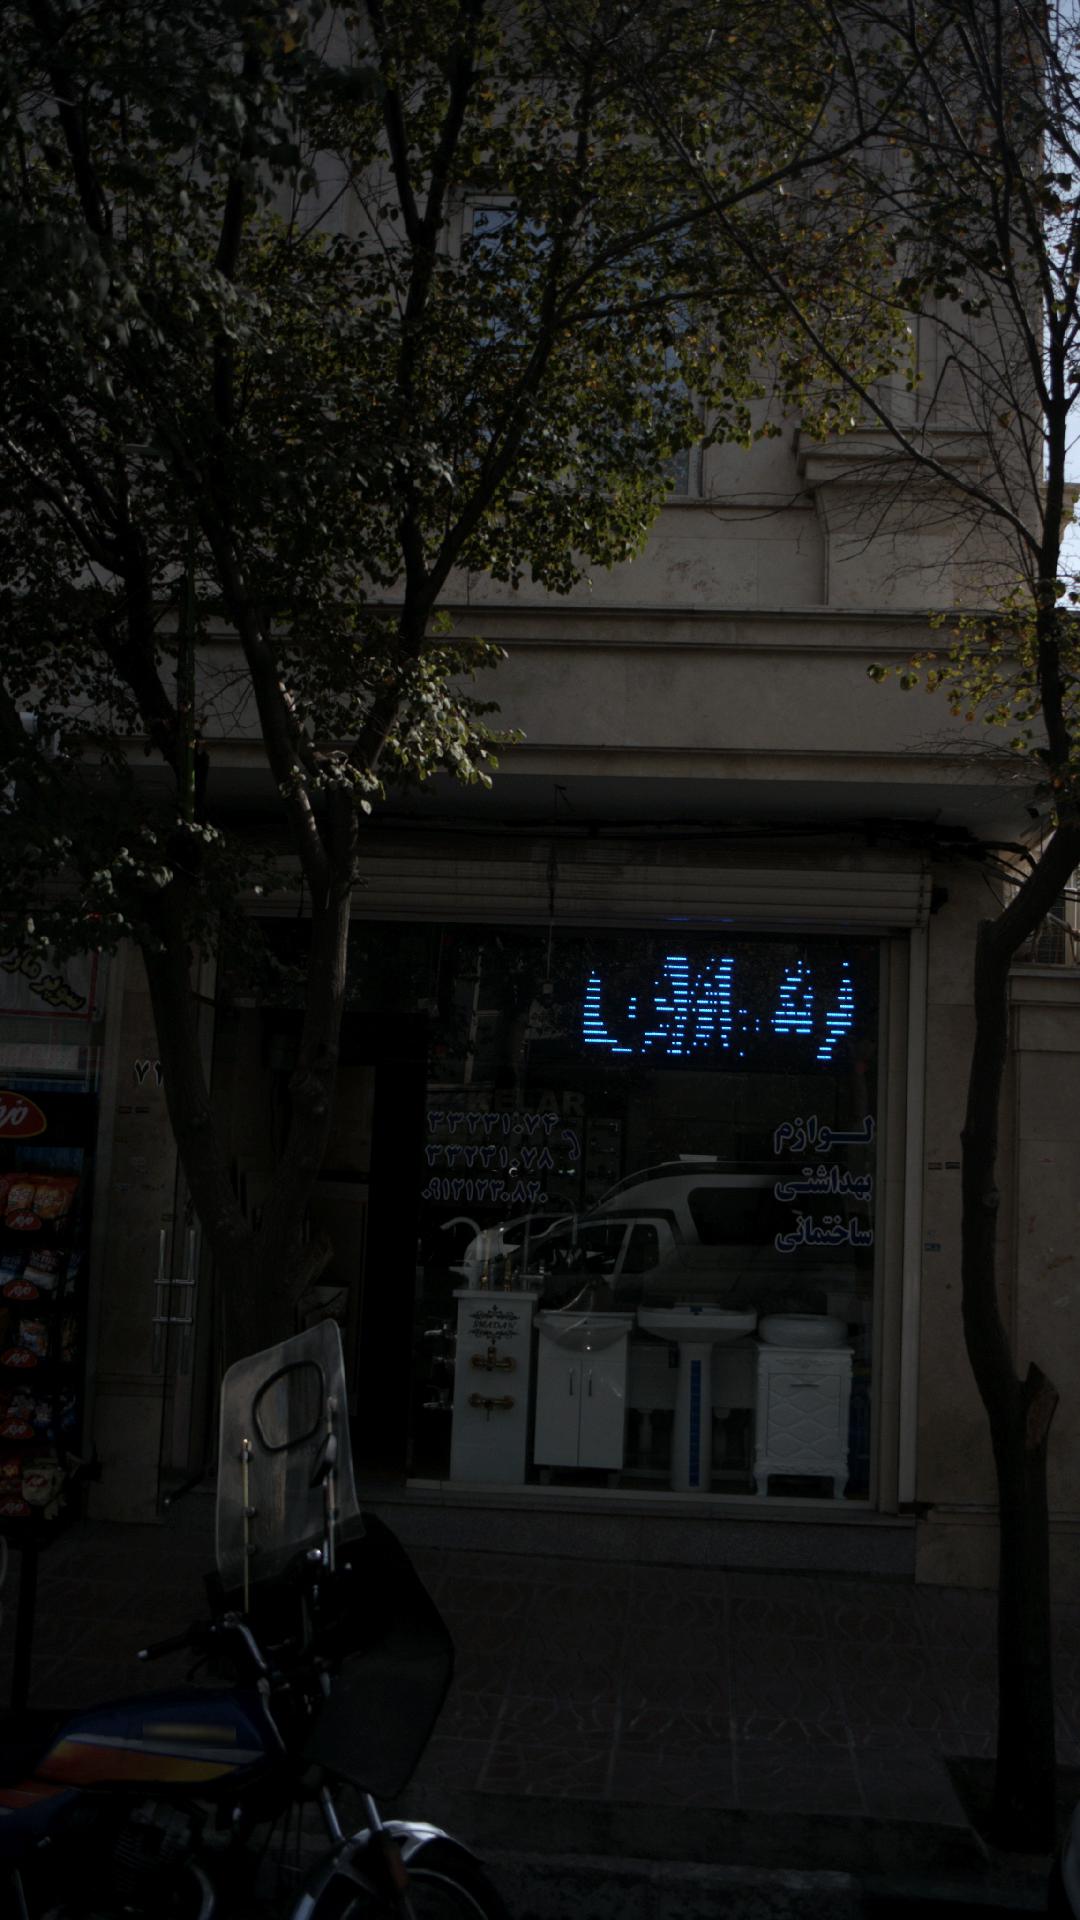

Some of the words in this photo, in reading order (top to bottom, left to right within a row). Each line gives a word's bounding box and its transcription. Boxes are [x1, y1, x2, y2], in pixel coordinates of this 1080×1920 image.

[774, 1115, 875, 1155] لوازم
[425, 1144, 554, 1169] ۳۳۲۳۱۰۷۸
[774, 1165, 873, 1201] بهداشتی
[775, 1215, 873, 1253] ساختمانی
